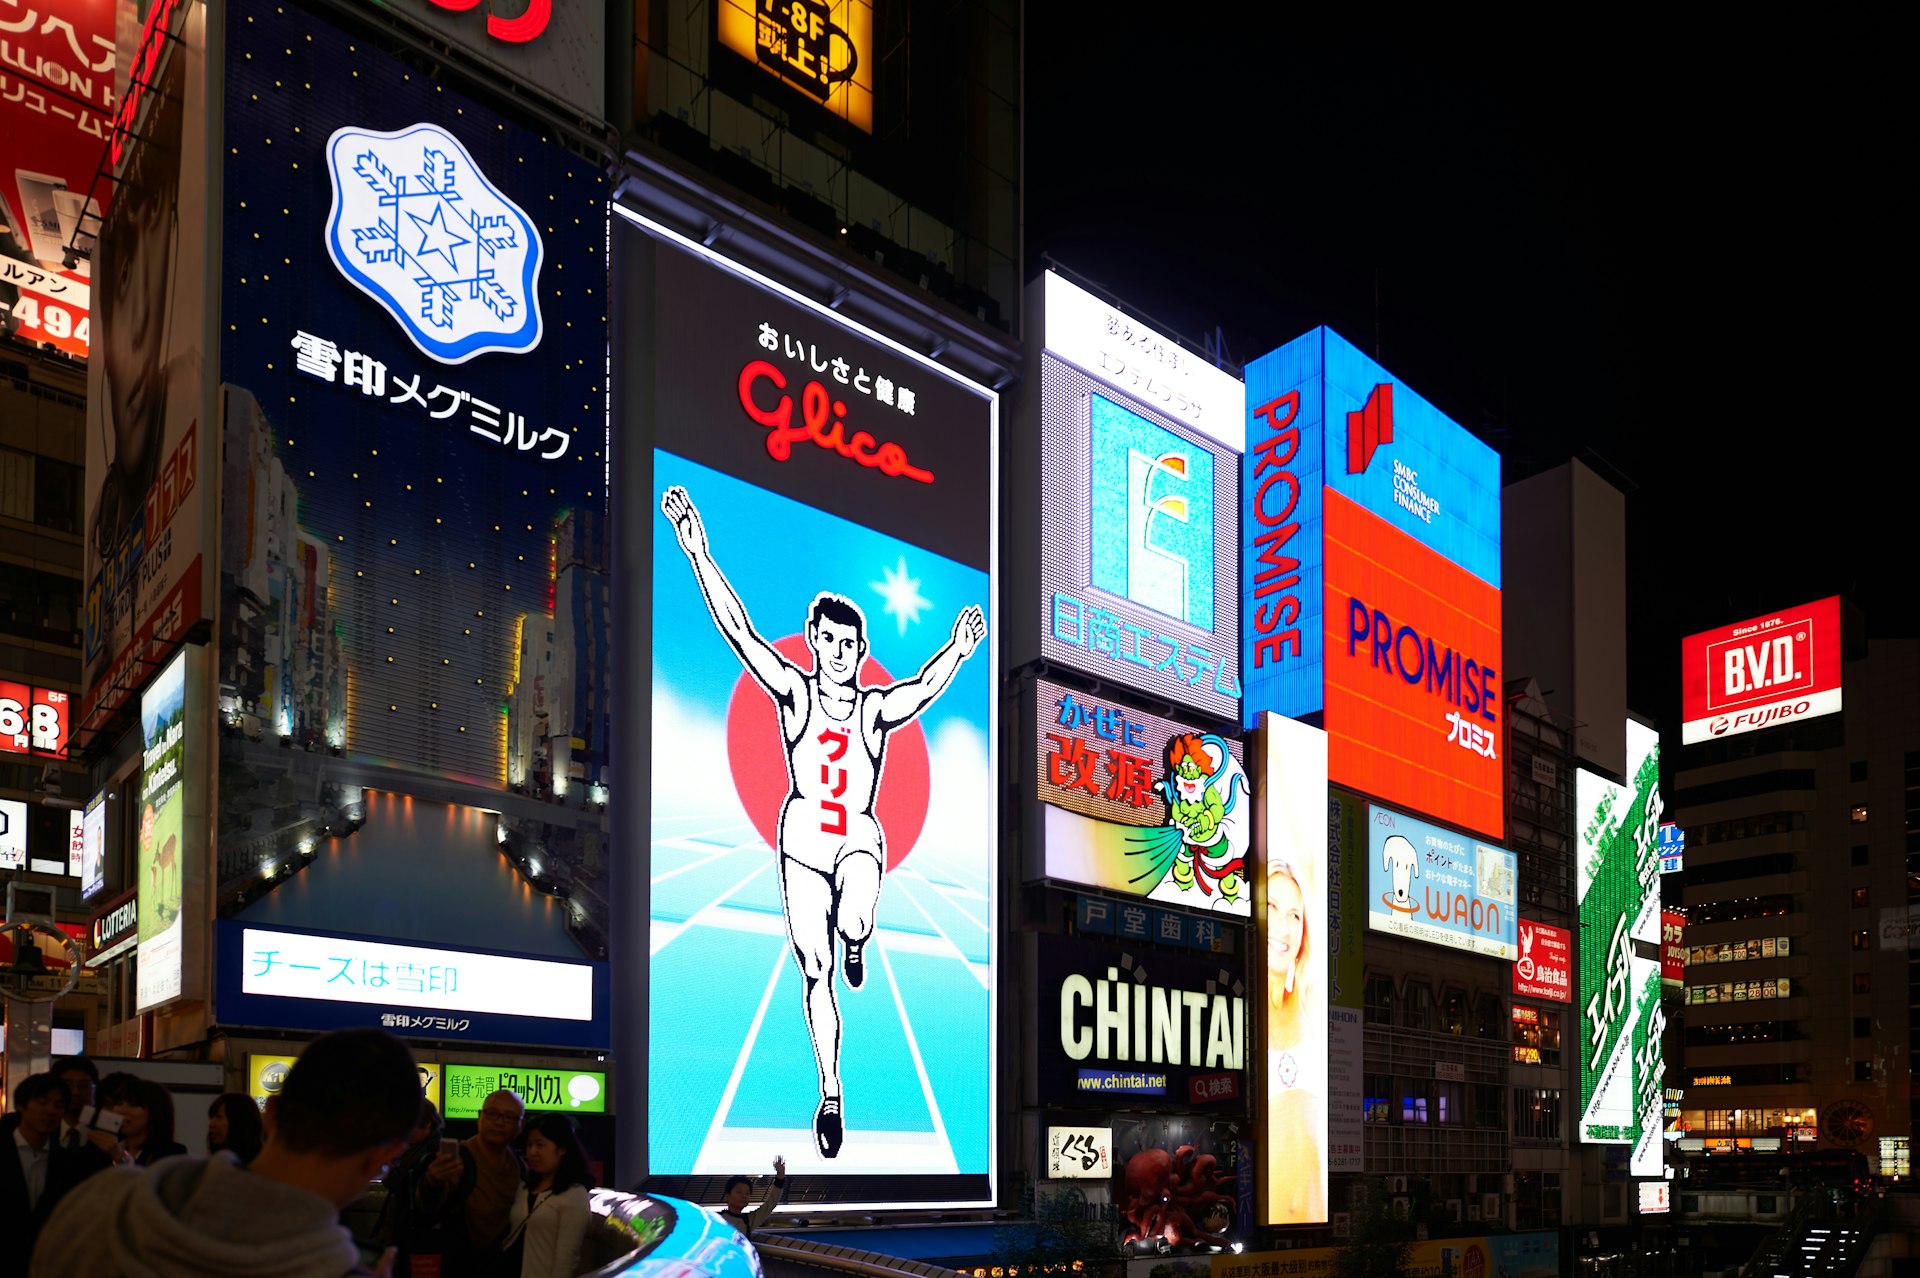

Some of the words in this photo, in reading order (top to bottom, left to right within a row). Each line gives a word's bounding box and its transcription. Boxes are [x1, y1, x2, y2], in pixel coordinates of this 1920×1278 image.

[291, 330, 570, 459] 雪印メグミルク
[758, 322, 916, 416] おいしさと健康
[738, 360, 935, 484] Glico
[1393, 459, 1418, 487] SMBC
[1393, 475, 1441, 516] CONSUMER
[1253, 389, 1301, 669] PROMISE
[1393, 491, 1432, 524] FINANCE
[1054, 593, 1242, 699] 日商エステム
[1732, 626, 1758, 637] Since
[1350, 597, 1496, 722] PROMISE
[1725, 635, 1802, 696] B.V.D.
[1059, 693, 1146, 748] かぜに
[1445, 711, 1497, 760] プロミス
[1733, 701, 1811, 729] FUJIBO
[817, 727, 851, 837] グリコ
[1049, 733, 1154, 809] 改源
[101, 899, 137, 941] LOTTERIA
[1425, 885, 1500, 935] WAON
[252, 950, 457, 995] チーズは雪印
[380, 1013, 470, 1032] 雪印メグミルク
[1060, 968, 1244, 1070] CHINTAI
[1208, 1077, 1233, 1096] 検索
